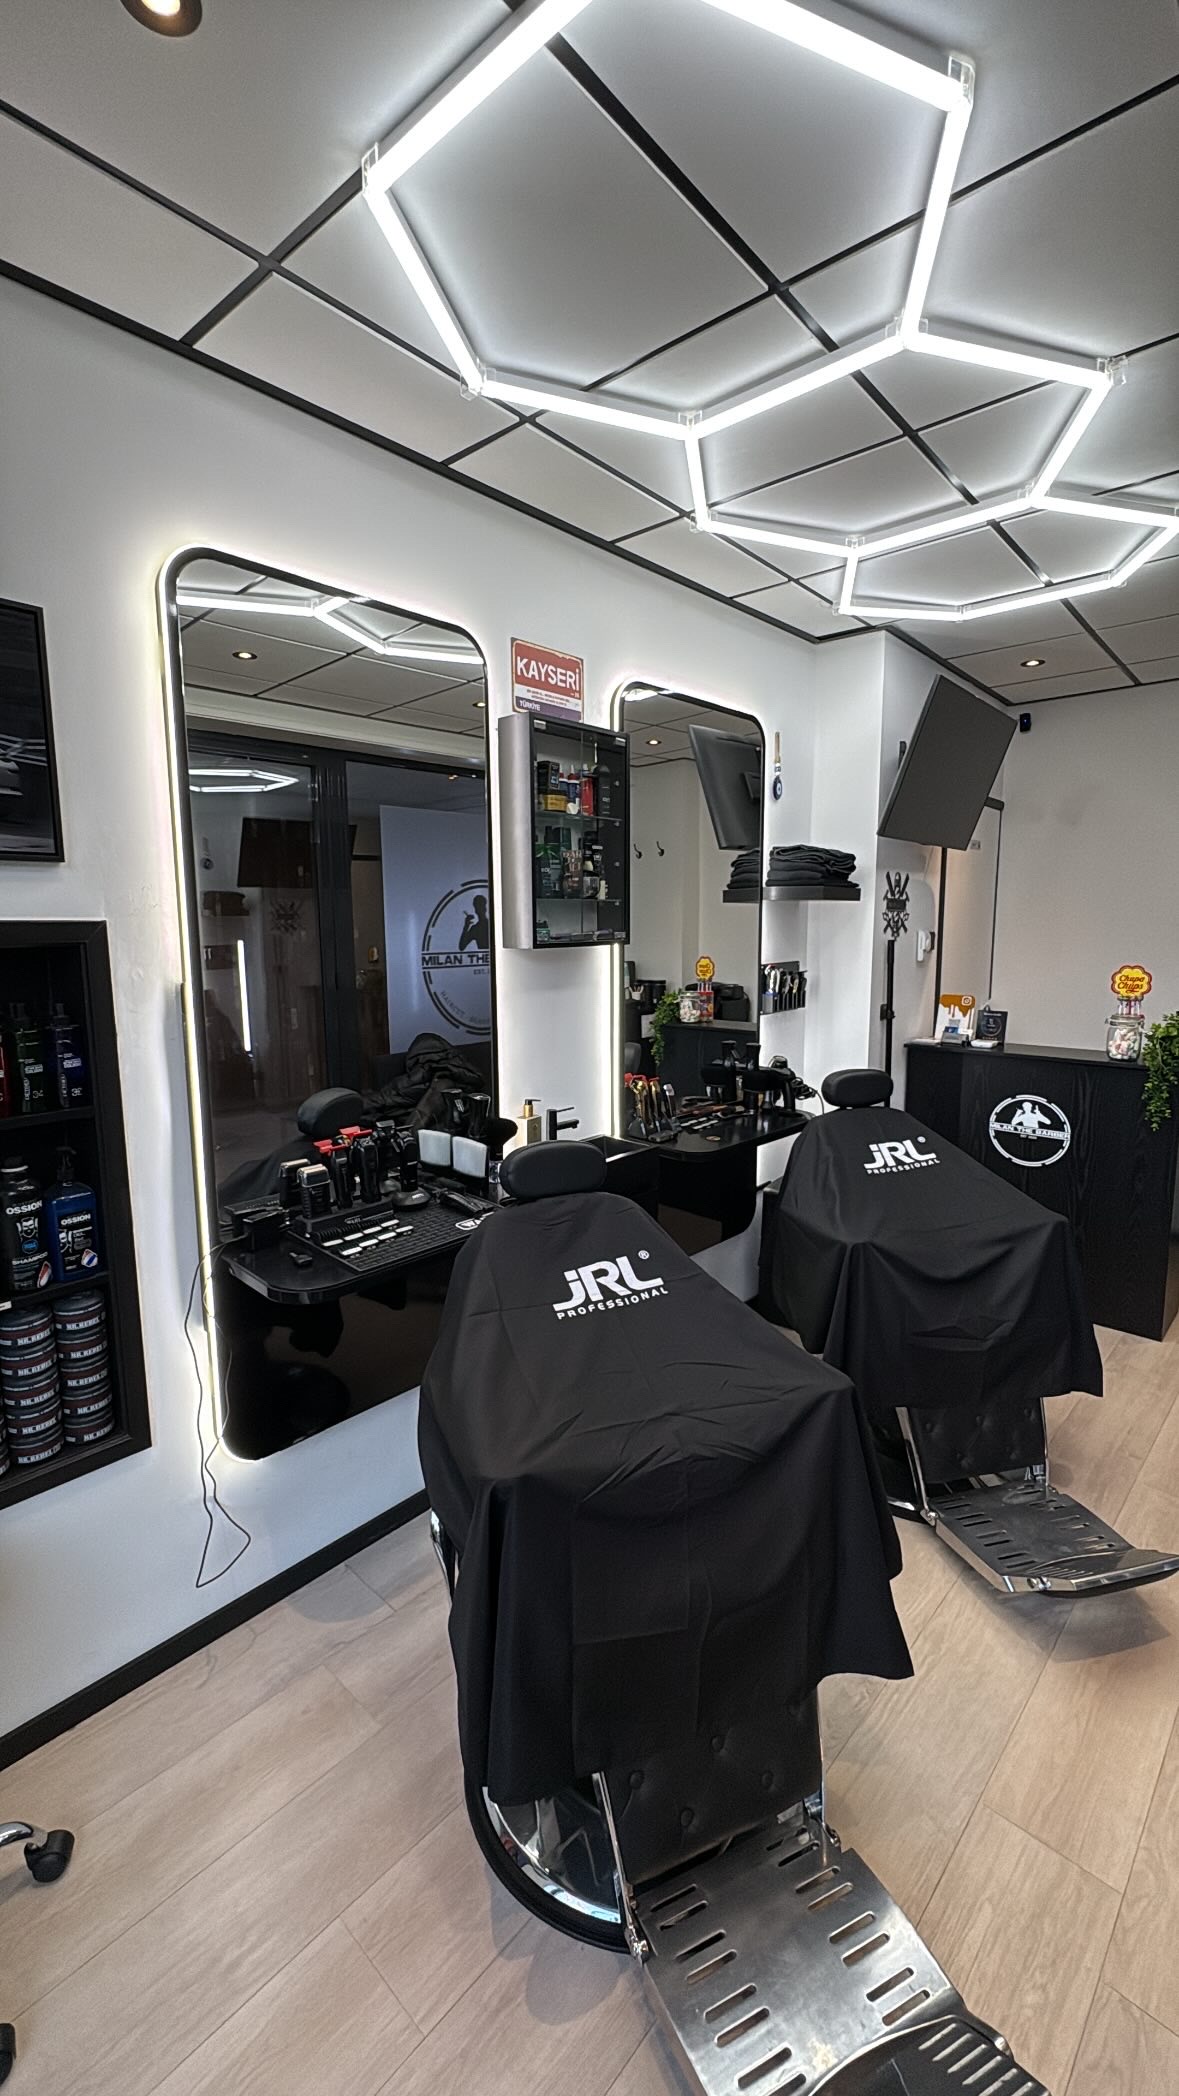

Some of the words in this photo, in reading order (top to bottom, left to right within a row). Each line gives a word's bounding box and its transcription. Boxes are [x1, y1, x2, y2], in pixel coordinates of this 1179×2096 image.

[516, 656, 580, 691] KAYSERİ
[422, 955, 463, 967] MILAN
[468, 953, 490, 964] THE
[1119, 974, 1145, 983] Chupa
[1117, 981, 1144, 993] Chups
[866, 1158, 941, 1175] PROFESSIONAL
[6, 1200, 43, 1215] OSSION
[61, 1213, 92, 1226] OSSION
[556, 1286, 669, 1320] PROFESSIONAL
